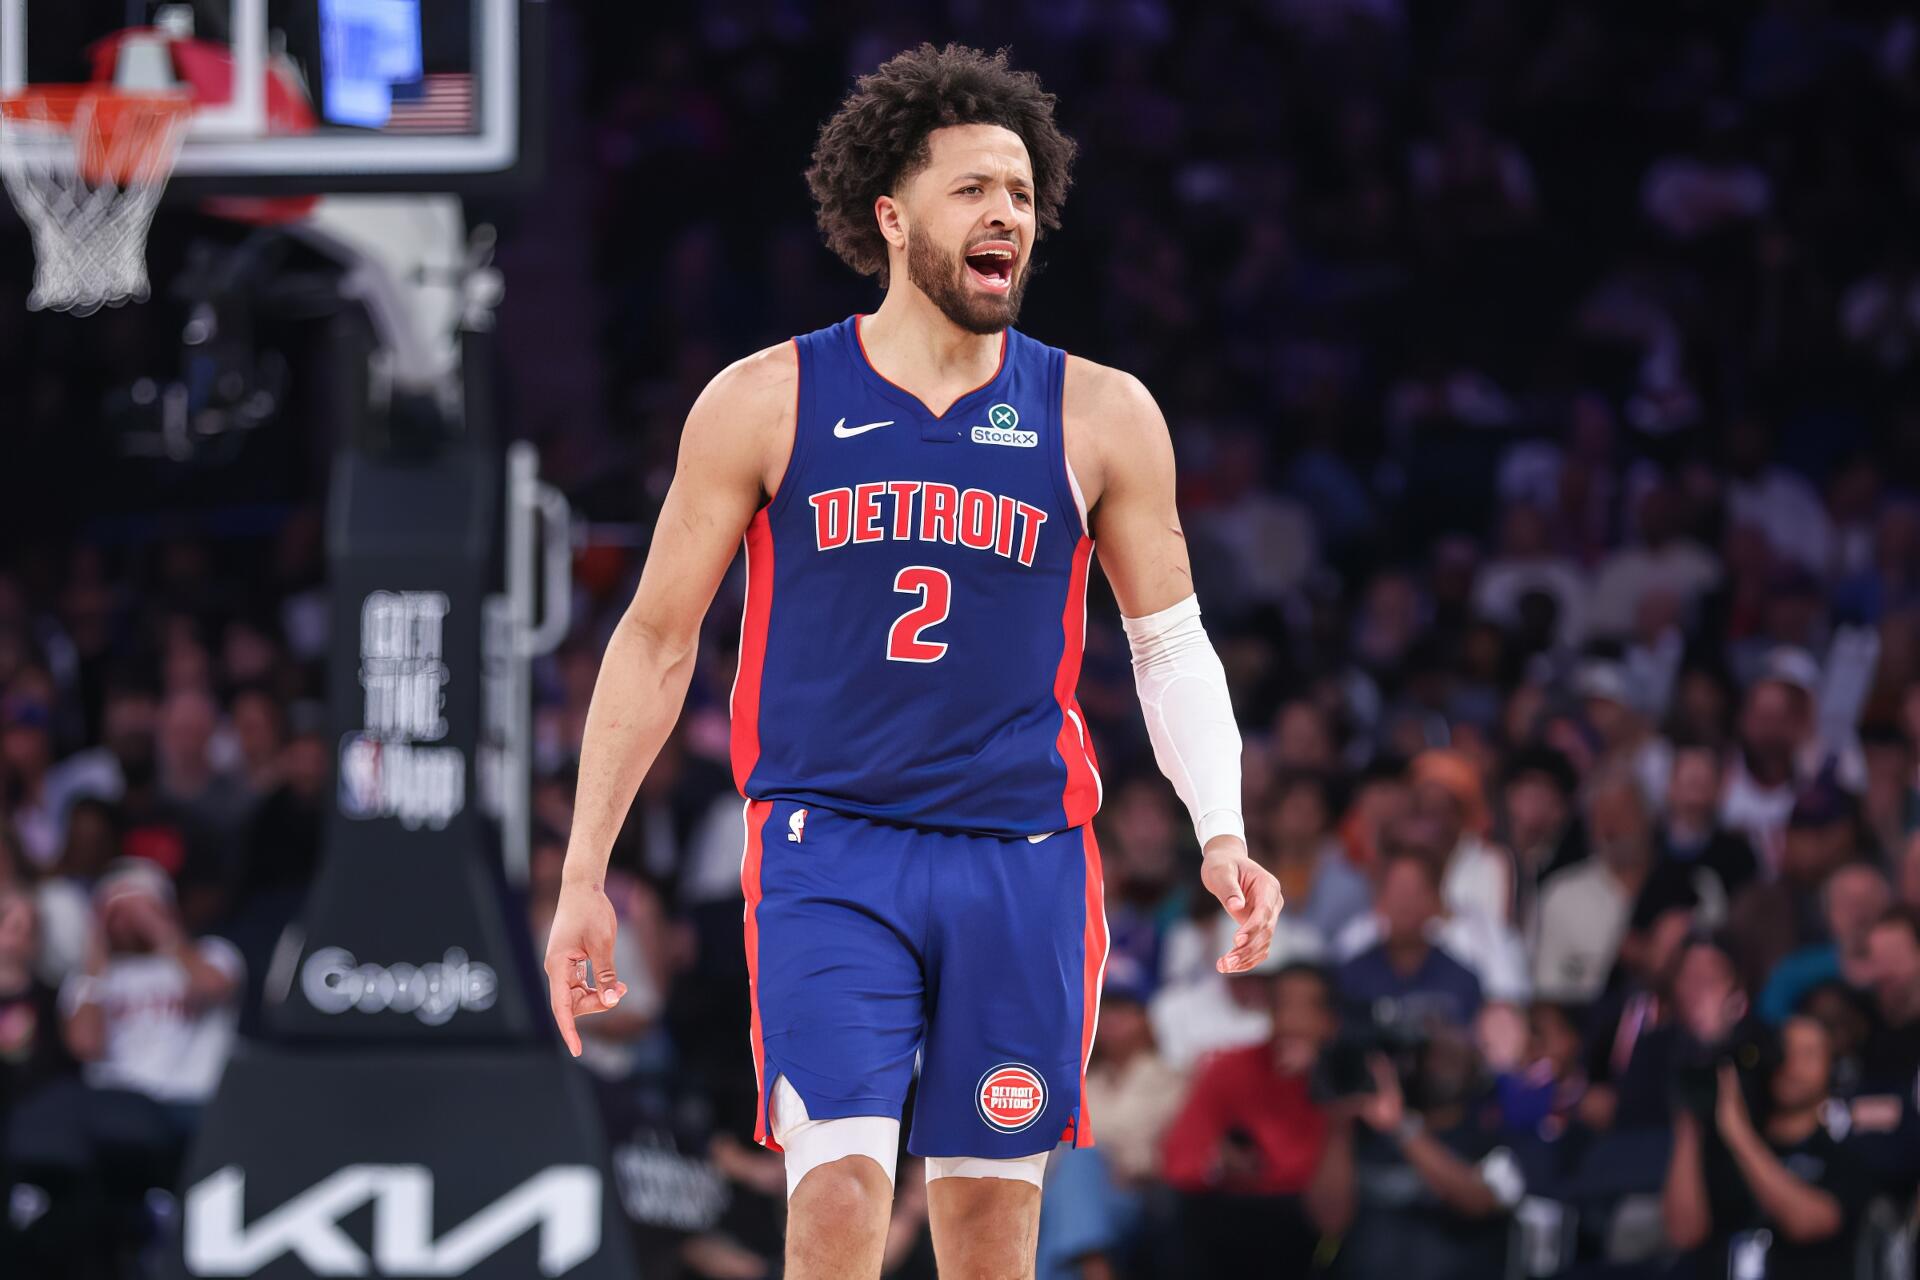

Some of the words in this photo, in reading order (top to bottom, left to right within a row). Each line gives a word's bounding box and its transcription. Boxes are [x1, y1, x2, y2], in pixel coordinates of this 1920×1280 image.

[974, 429, 1035, 444] StockX
[809, 481, 1048, 567] DETROIT
[886, 565, 951, 663] 2
[991, 1086, 1034, 1098] DETROIT
[990, 1098, 1033, 1109] PISTONS
